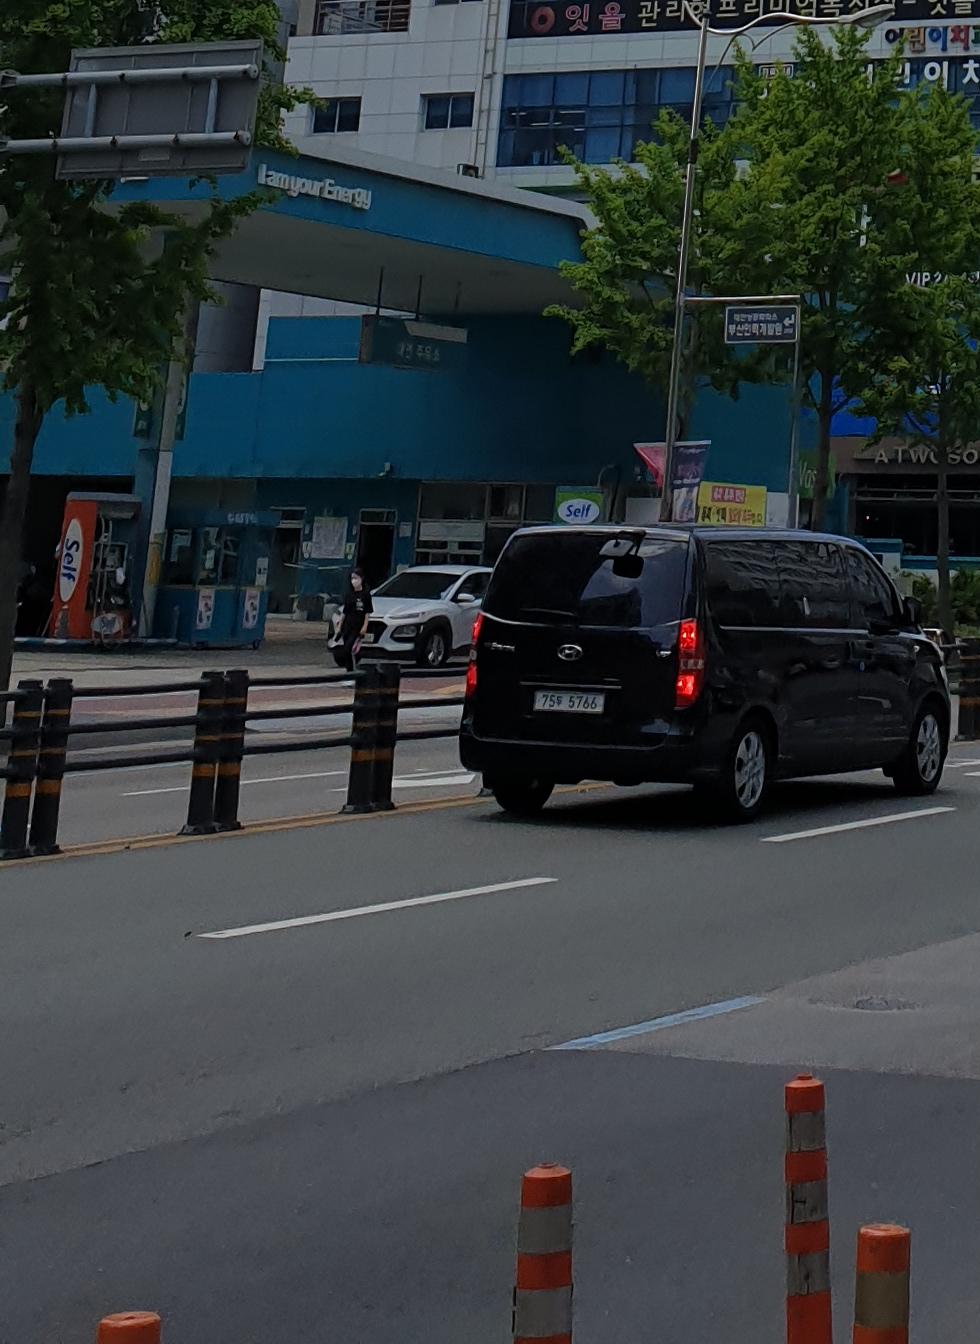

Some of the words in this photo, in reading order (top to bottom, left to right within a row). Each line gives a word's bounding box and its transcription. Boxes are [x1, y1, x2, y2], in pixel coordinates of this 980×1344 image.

[564, 0, 626, 32] 잇올
[266, 170, 289, 189] am
[287, 176, 324, 198] your
[321, 178, 373, 210] Energy
[874, 449, 889, 464] A
[564, 502, 592, 519] Self
[61, 537, 80, 583] Self
[567, 695, 598, 710] 5766
